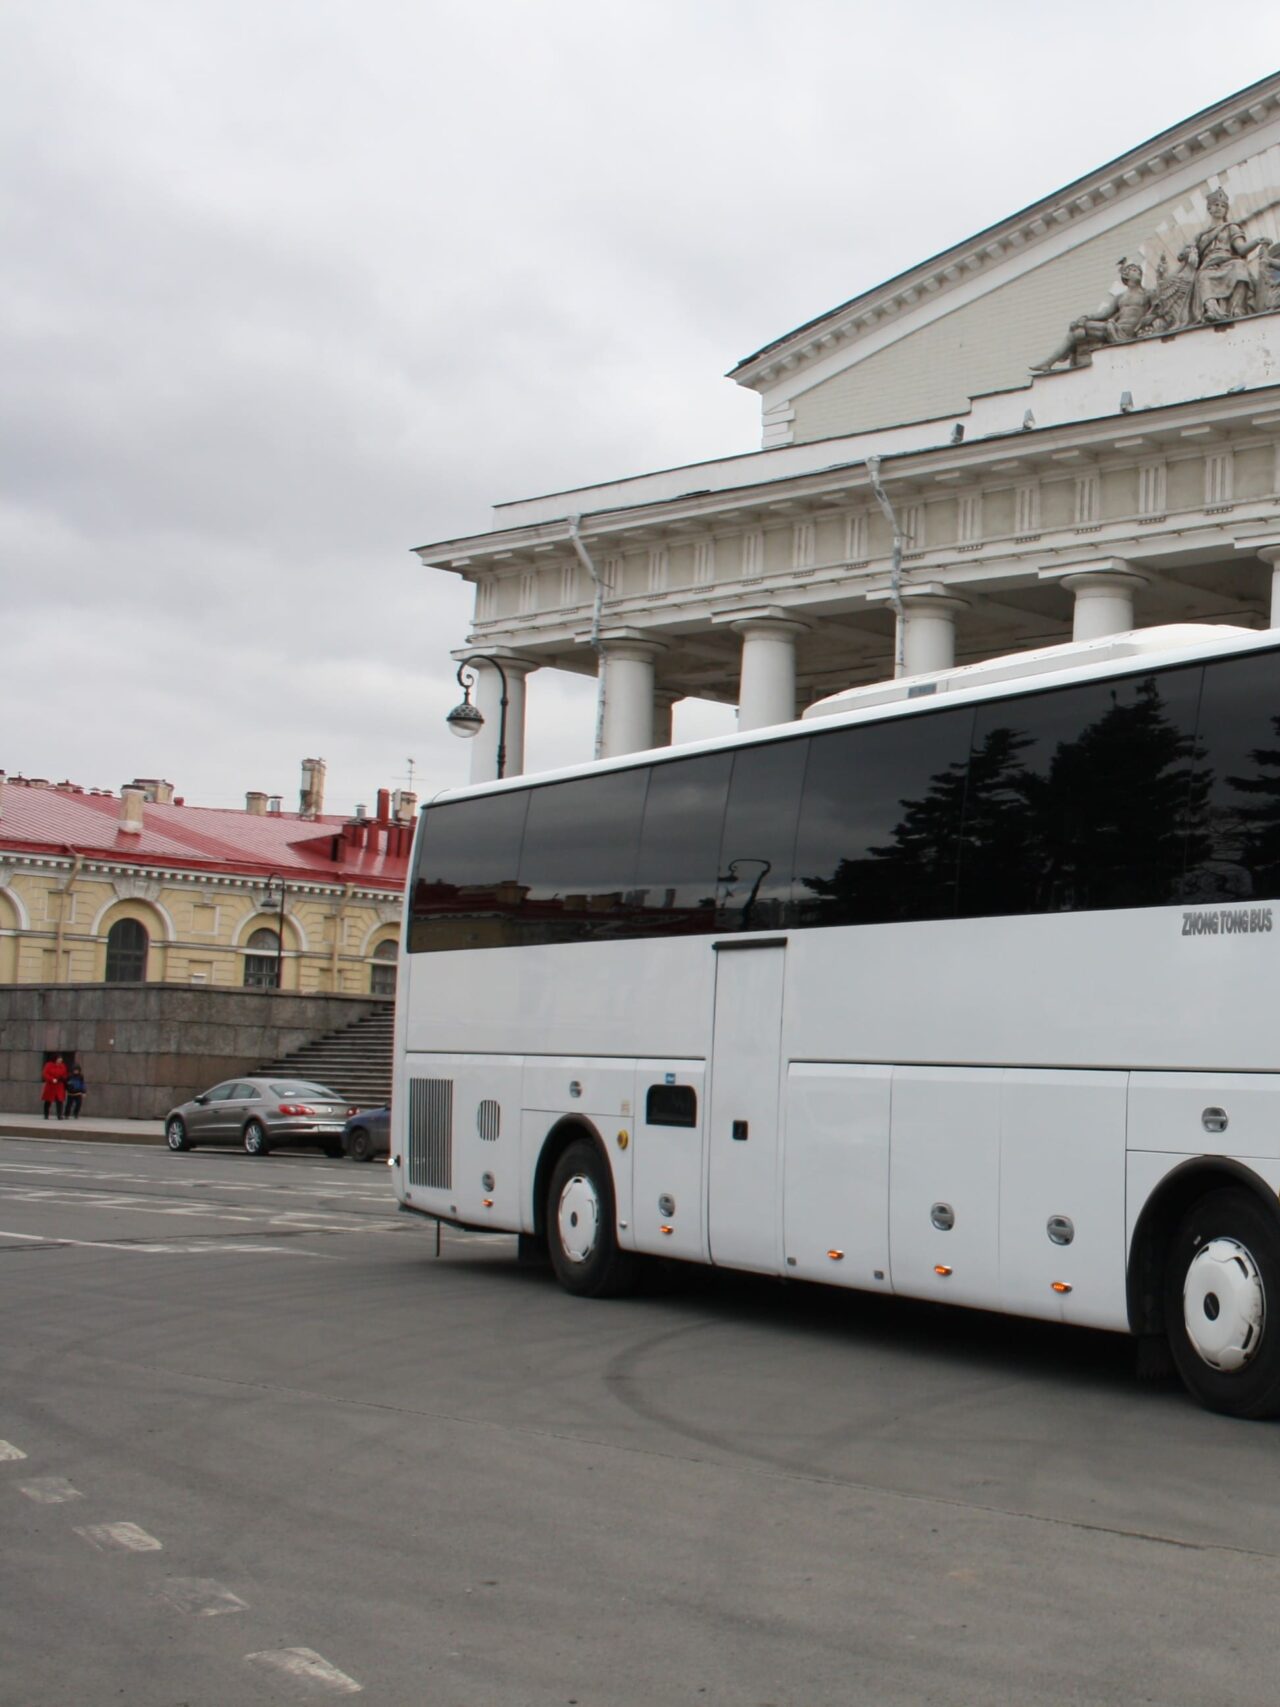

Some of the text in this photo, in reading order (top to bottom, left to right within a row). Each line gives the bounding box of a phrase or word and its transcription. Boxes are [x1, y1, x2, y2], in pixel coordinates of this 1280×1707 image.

[1181, 908, 1273, 936] ZHONG TONG BUS
